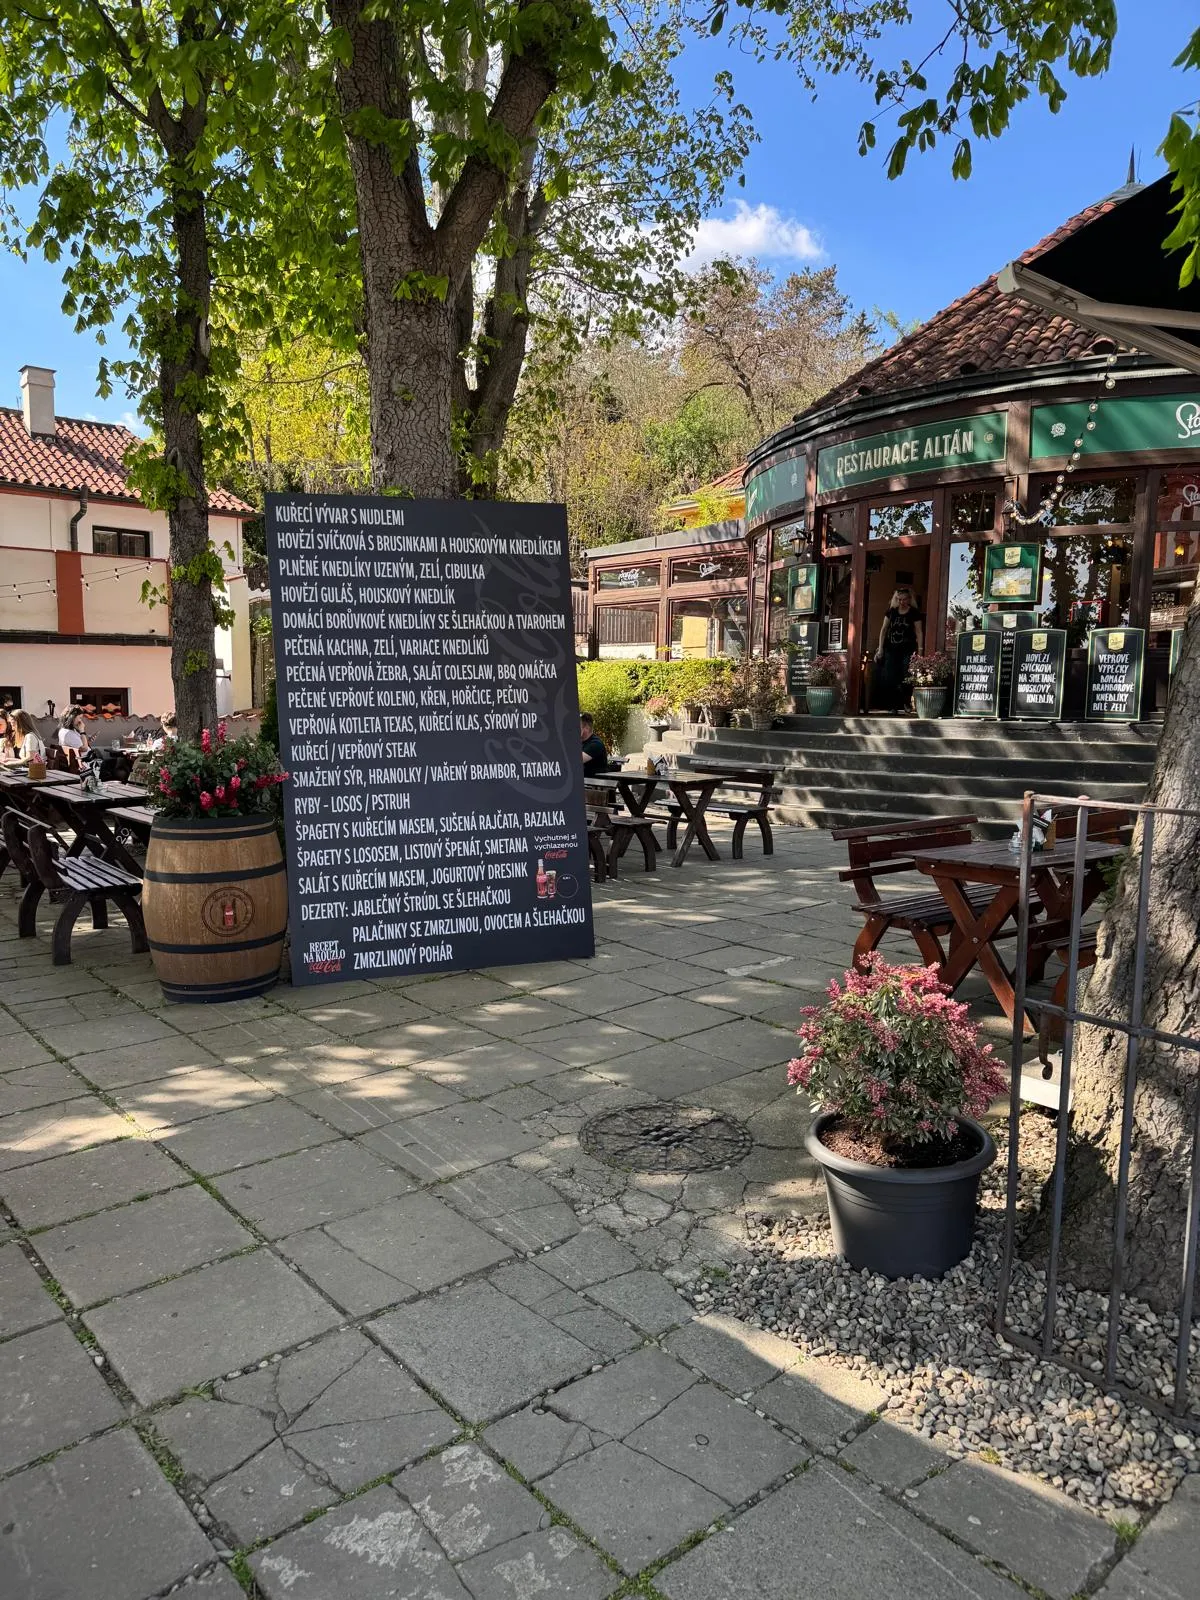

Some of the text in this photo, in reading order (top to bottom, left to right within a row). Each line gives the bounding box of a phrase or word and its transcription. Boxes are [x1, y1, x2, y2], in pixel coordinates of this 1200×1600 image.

[836, 428, 974, 478] RESTAURACE ALTÁN
[276, 506, 404, 525] KUŘECÍ VÝVAR S NUDLEMI
[278, 529, 561, 555] HOVĚZÍ SVÍČKOVÁ S BRUSINKAMI A HOUSKOVÝM KNEDLÍKEM
[280, 558, 485, 580] PLNĚNÉ KNEDLÍKY UZENÝM, ZELÍ, CIBULKA
[281, 585, 455, 606] HOVĚZÍ GULÁŠ, HOUSKOVÝ KNEDLÍK
[283, 609, 565, 629] DOMÁCÍ BORŮVKOVÉ KNEDLÍKY SE ŠLEHAČKOU A TVAROHEM
[285, 634, 489, 658] PEČENÁ KACHNA, ZELÍ, VARIACE KNEDLÍKŮ
[287, 661, 556, 683] PEČENÁ VEPŘOVÁ ŽEBRA, SALÁT COLESLAW, BBQ OMÁČKA
[288, 686, 528, 709] PEČENÉ VEPŘOVÉ KOLENO, KŘEN, HOŘČICE, PEČIVO
[290, 711, 537, 735] VEPŘOVÁ KOTLETA TEXAS, KUŘECÍ KLAS, SÝROVÝ DIP
[292, 741, 416, 763] KUŘECÍ / VEPŘOVÝ STEAK
[293, 761, 560, 788] SMAŽENÝ SÝR, HRANOLKY / VAŘENÝ BRAMBOR, TATARKA
[295, 797, 321, 814] RYBY
[331, 795, 363, 812] LOSOS
[365, 794, 369, 813] /
[371, 793, 410, 810] PSTRUH
[296, 810, 565, 841] ŠPAGETY S KUŘECÍM MASEM, SUŠENÁ RAJČATA, BAZALKA
[534, 834, 569, 842] Vychutnej
[534, 842, 578, 850] vychlazenou
[297, 838, 528, 868] ŠPAGETY S LOSOSEM, LISTOVÝ ŠPENÁT, SMETANA
[299, 861, 527, 895] SALÁT S KUŘECÍM MASEM, JOGURTOVÝ DRESINK
[302, 888, 510, 921] DEZERTY: JABLEČNÝ ŠTRÚDL SE ŠLEHAČKOU
[353, 907, 585, 943] PALAČINKY SE ZMRZLINOU, OVOCEM A ŠLEHAČKOU
[304, 949, 345, 963] NA KOUZLO
[309, 940, 339, 952] RECEPT
[354, 943, 452, 970] ZMRZLINOVÝ POHÁR
